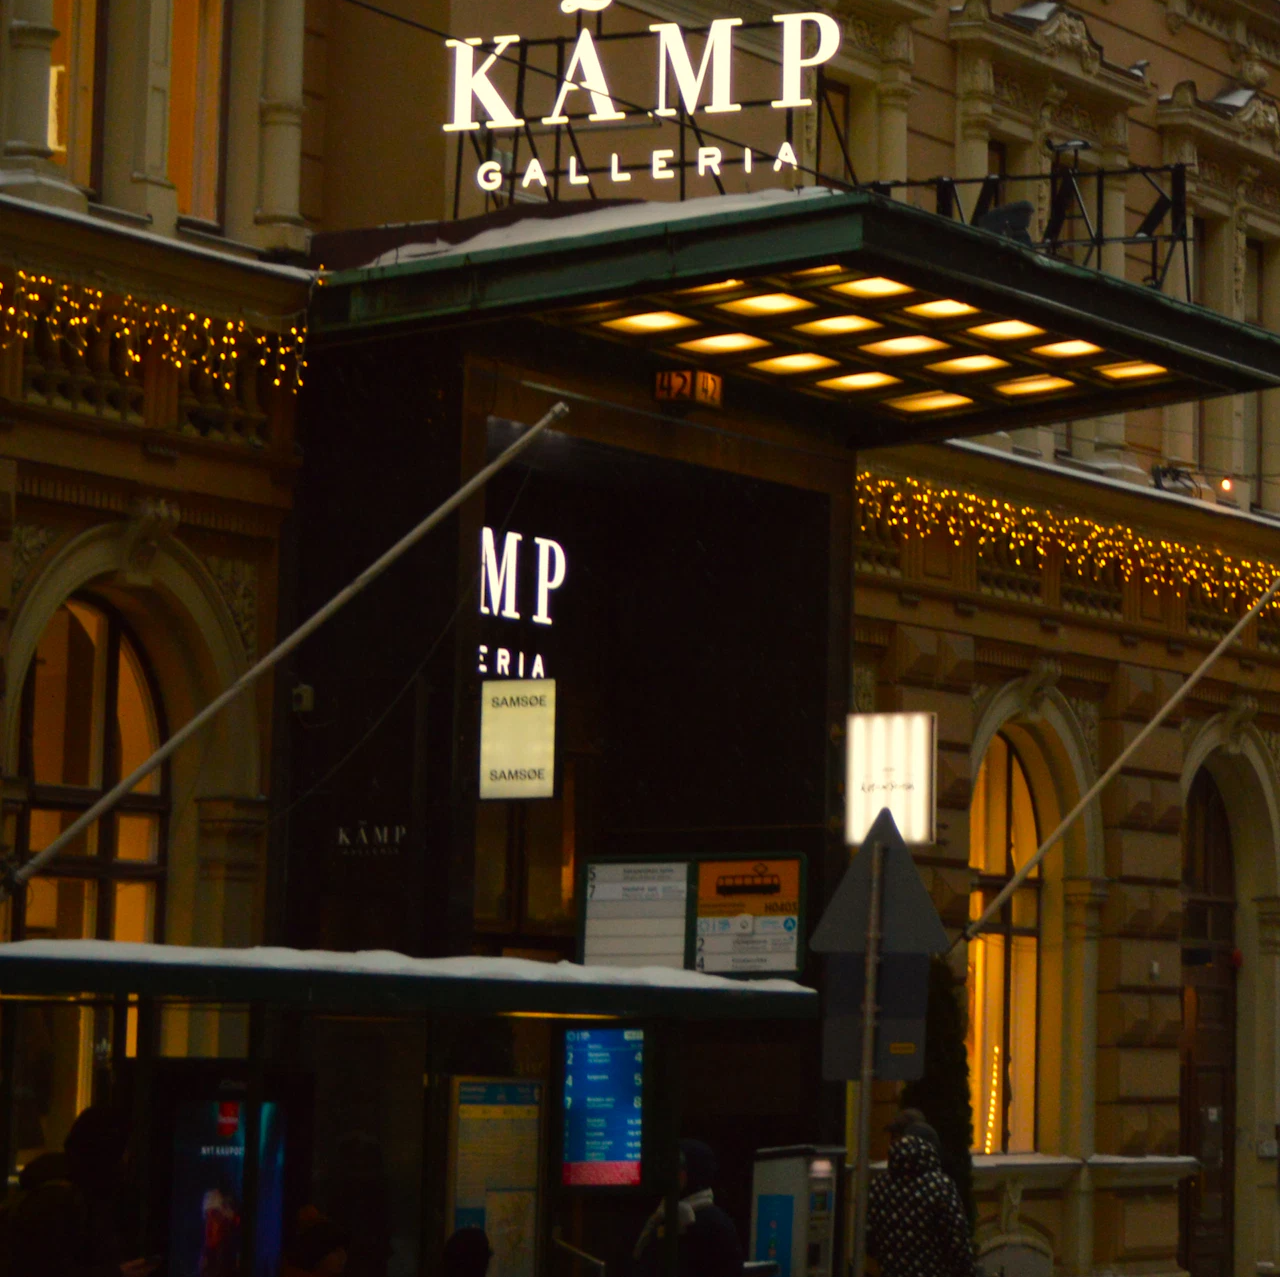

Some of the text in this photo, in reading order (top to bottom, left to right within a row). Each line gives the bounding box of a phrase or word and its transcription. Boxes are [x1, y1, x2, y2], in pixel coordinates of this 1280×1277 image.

[476, 141, 799, 192] GALLERIA
[490, 694, 548, 710] SAMSØE
[488, 767, 546, 783] SAMSØE
